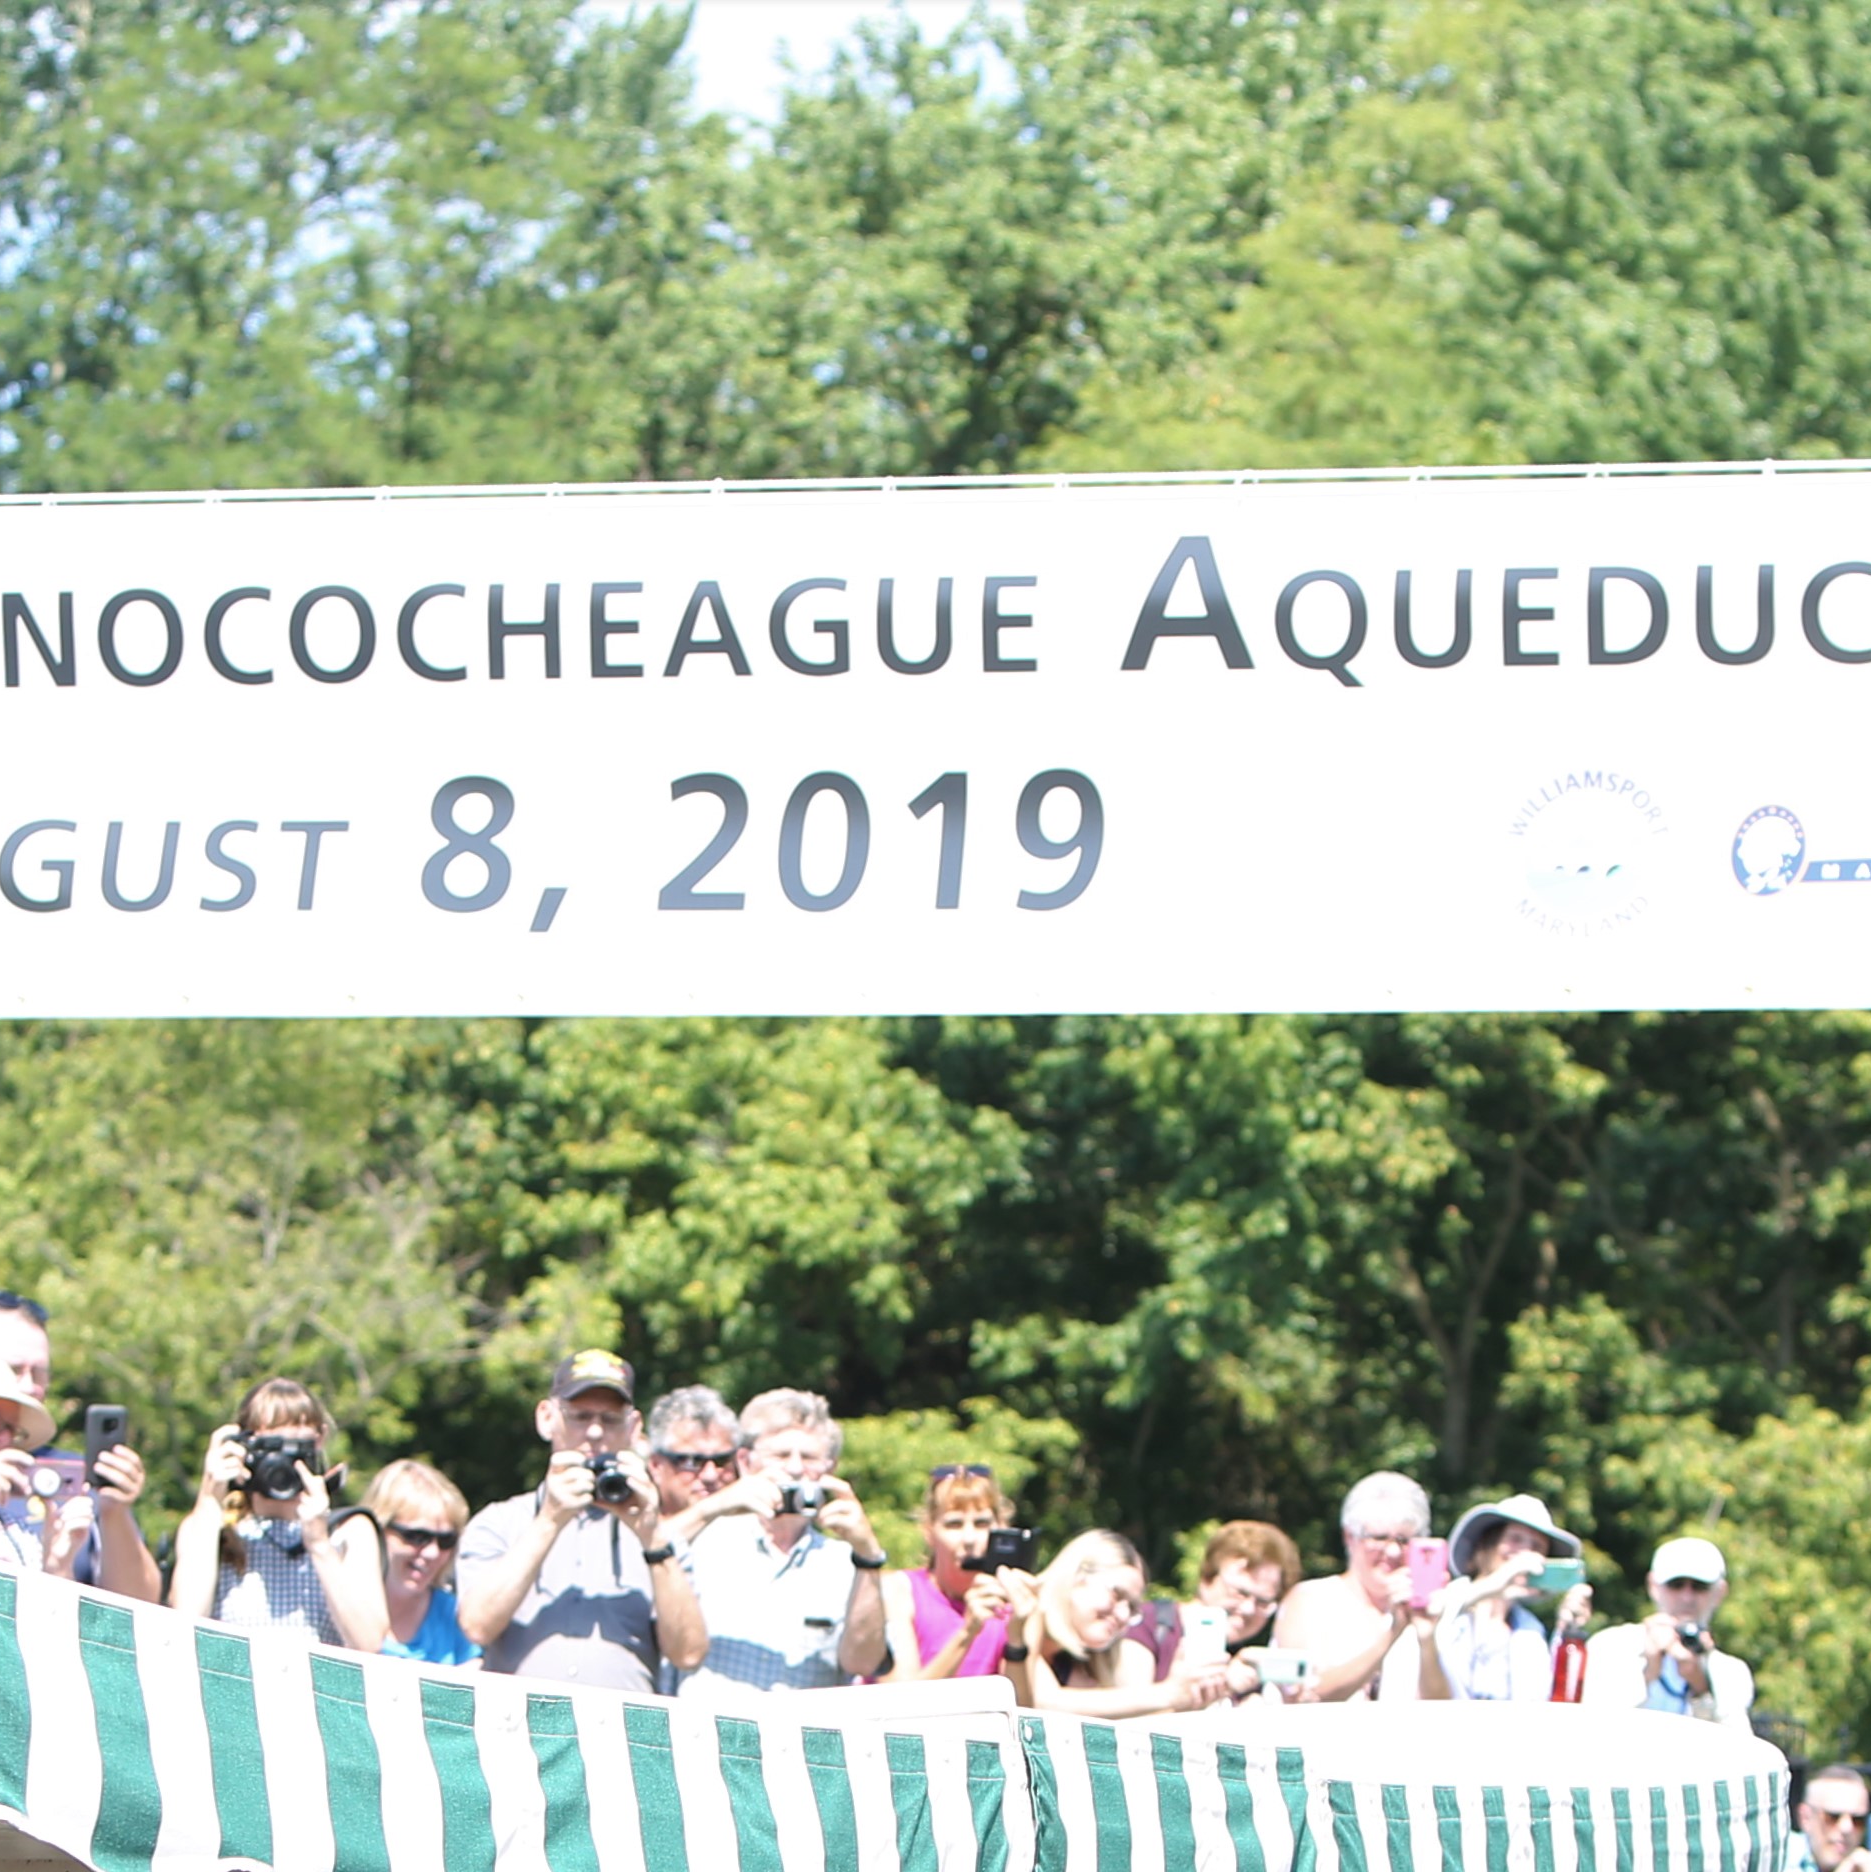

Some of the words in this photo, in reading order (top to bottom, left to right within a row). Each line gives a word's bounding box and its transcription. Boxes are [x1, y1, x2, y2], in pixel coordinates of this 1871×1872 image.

[419, 773, 569, 934] 8,
[656, 766, 1106, 914] 2019
[1507, 768, 1670, 836] WILLIAMSPORT
